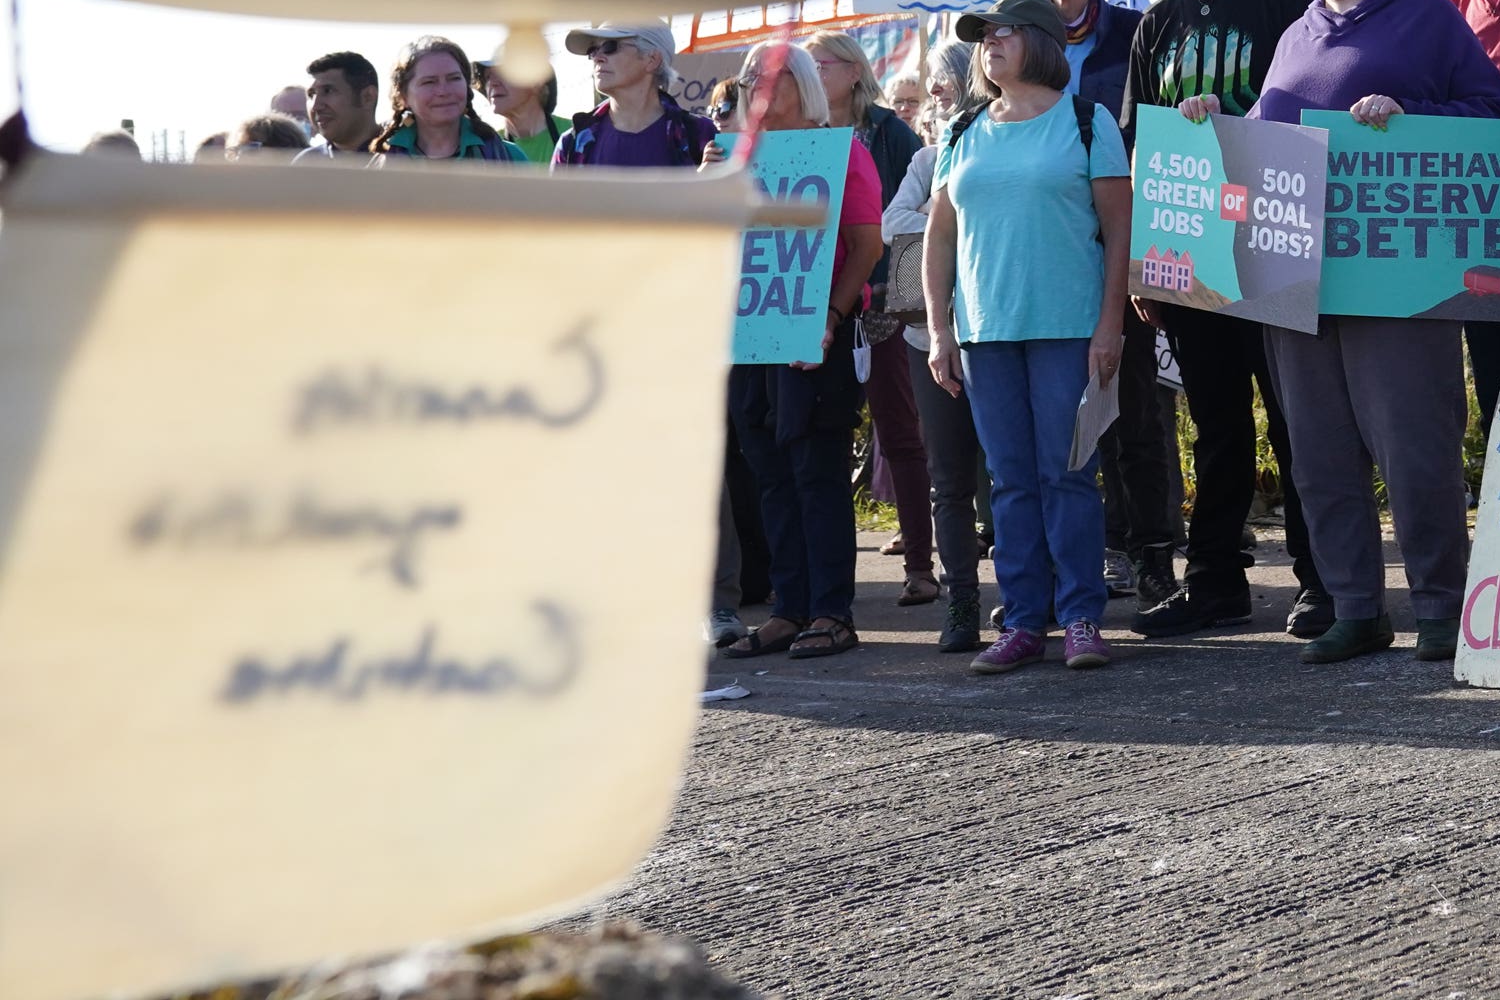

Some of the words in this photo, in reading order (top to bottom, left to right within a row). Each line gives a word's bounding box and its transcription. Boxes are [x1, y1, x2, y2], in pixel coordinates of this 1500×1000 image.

[1148, 151, 1212, 182] 4,500
[1142, 177, 1214, 211] GREEN
[1262, 168, 1306, 198] 500
[1224, 193, 1245, 212] or
[1253, 197, 1312, 231] COAL
[1150, 207, 1204, 239] JOBS
[741, 229, 826, 274] EW
[1247, 227, 1314, 259] JOBS?
[736, 275, 817, 317] OAL
